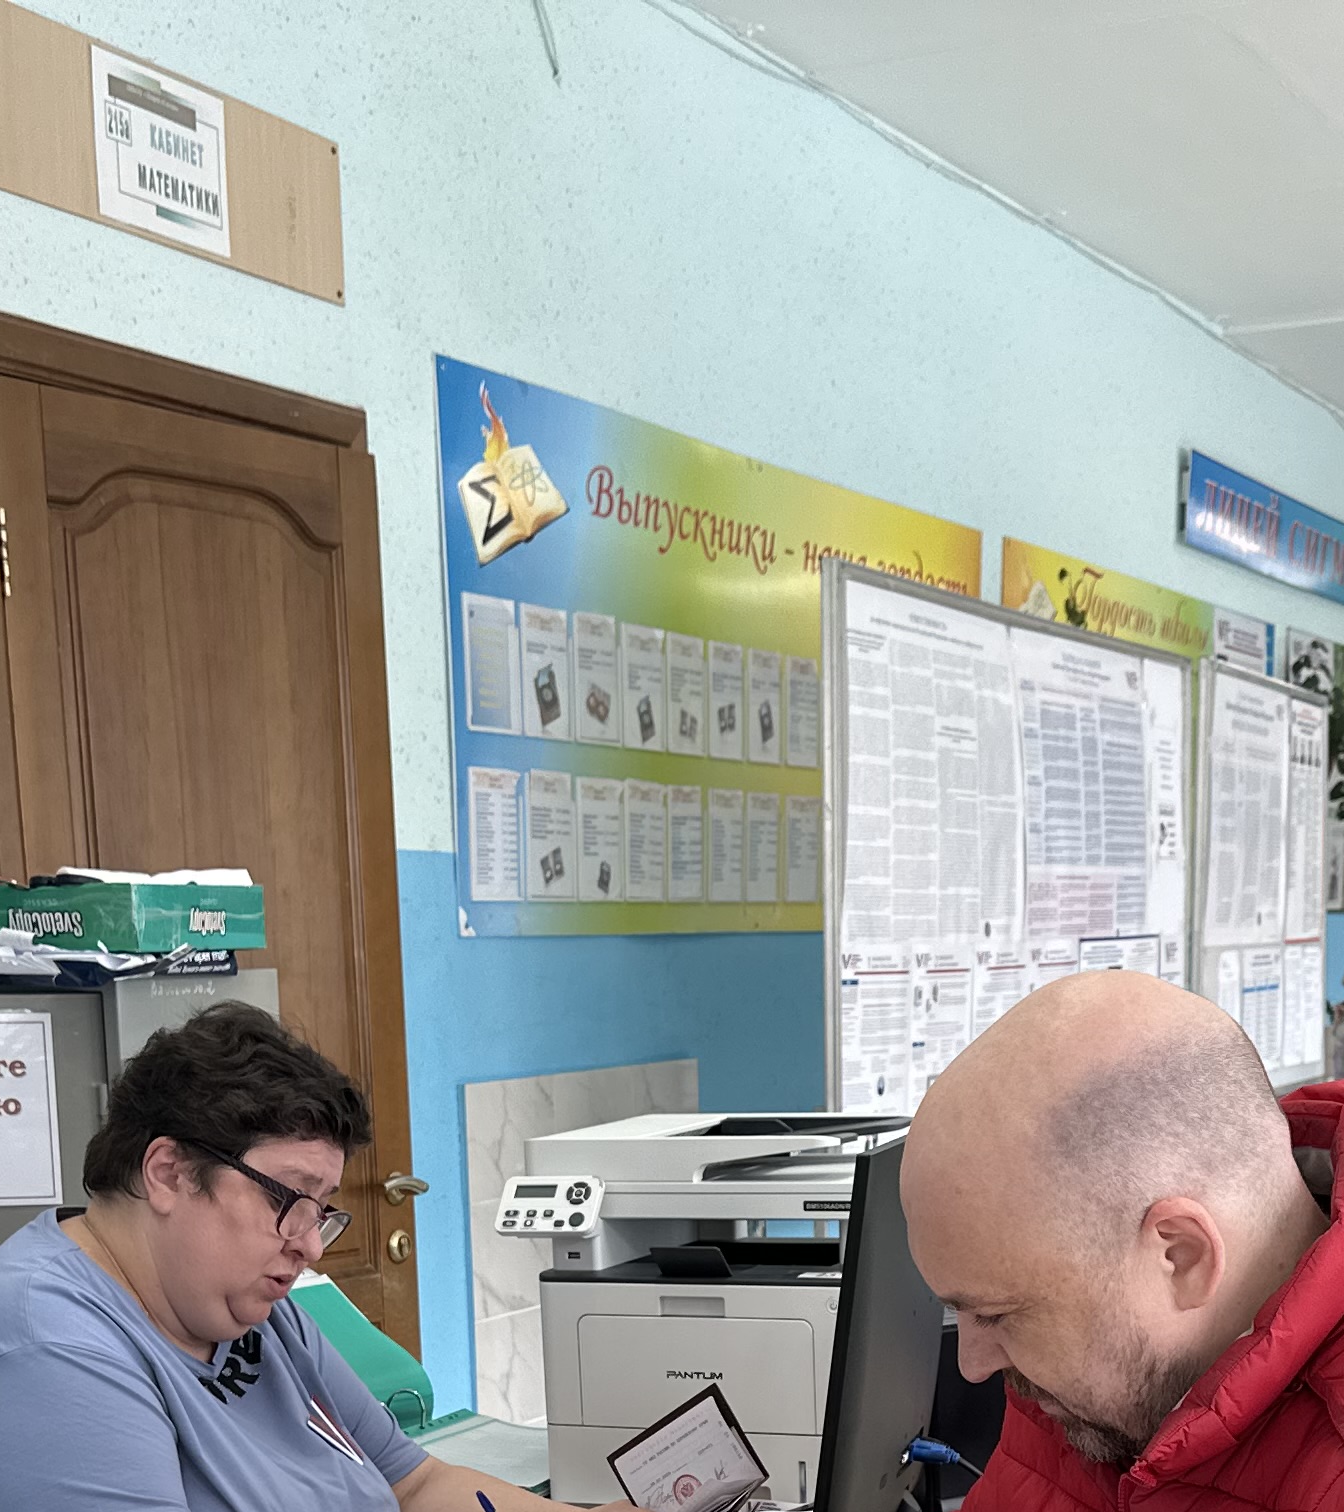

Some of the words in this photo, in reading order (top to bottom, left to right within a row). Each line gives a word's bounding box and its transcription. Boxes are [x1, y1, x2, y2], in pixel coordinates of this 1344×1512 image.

[150, 122, 204, 169] КАБИНЕТ
[137, 162, 220, 219] МАТЕМАТИКИ
[585, 464, 777, 576] Выпускники
[7, 908, 83, 940] SvetoCopy
[666, 1371, 724, 1381] PANTUM
